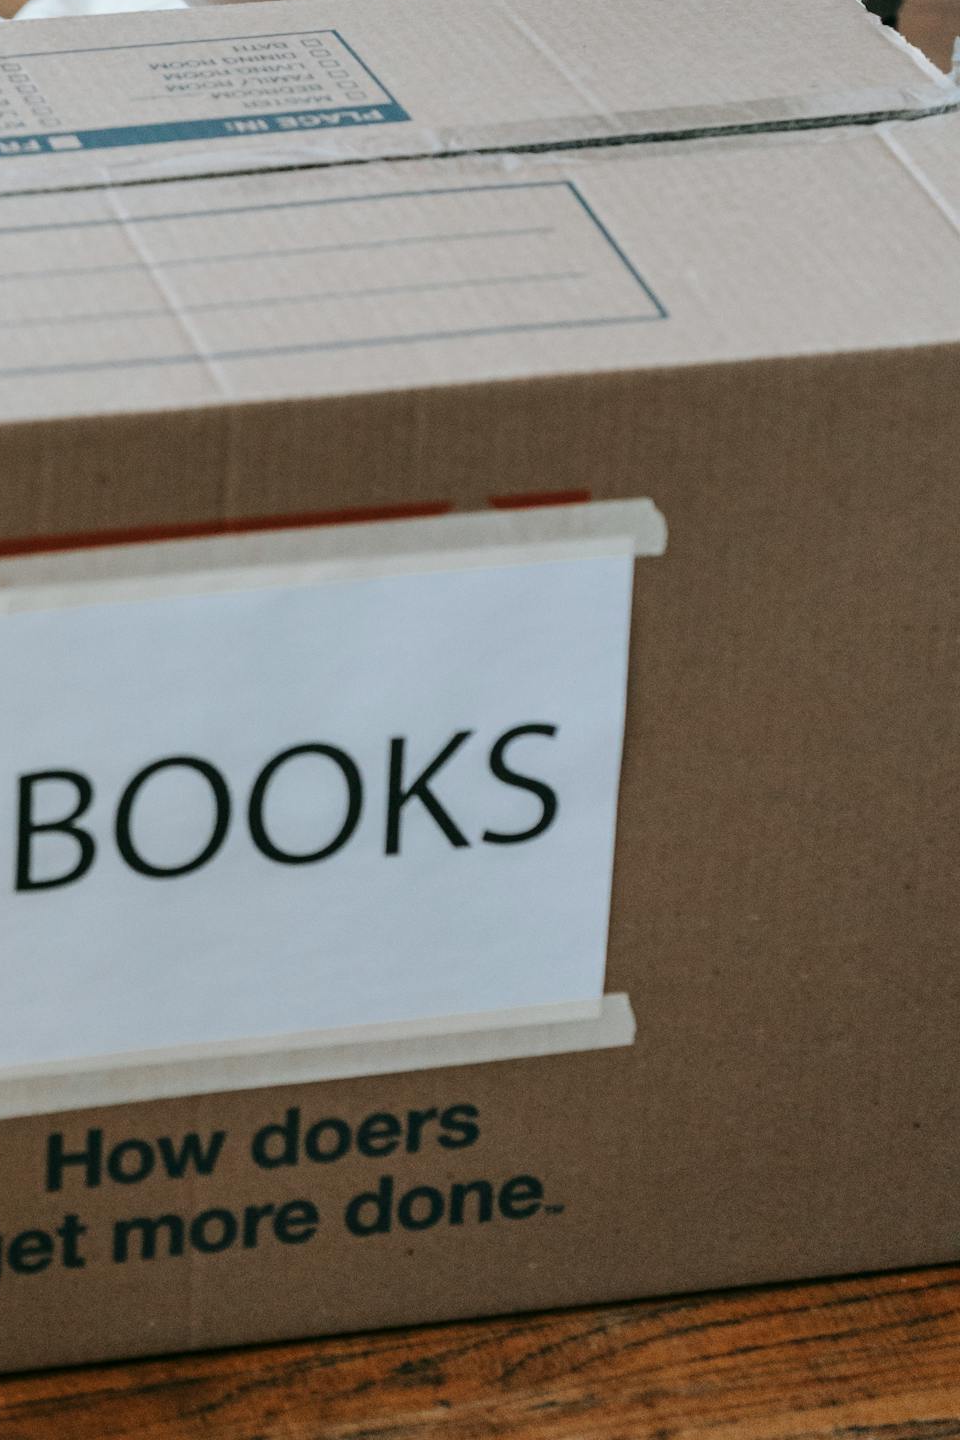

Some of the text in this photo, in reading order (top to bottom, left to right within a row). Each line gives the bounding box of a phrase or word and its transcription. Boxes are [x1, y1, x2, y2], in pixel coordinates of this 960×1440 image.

[211, 83, 323, 100] BEDROOM
[242, 94, 333, 109] MASTER
[224, 108, 384, 133] PLACE IN:
[13, 721, 559, 894] BOOKS
[45, 1100, 483, 1194] How doers
[111, 1196, 321, 1265] more
